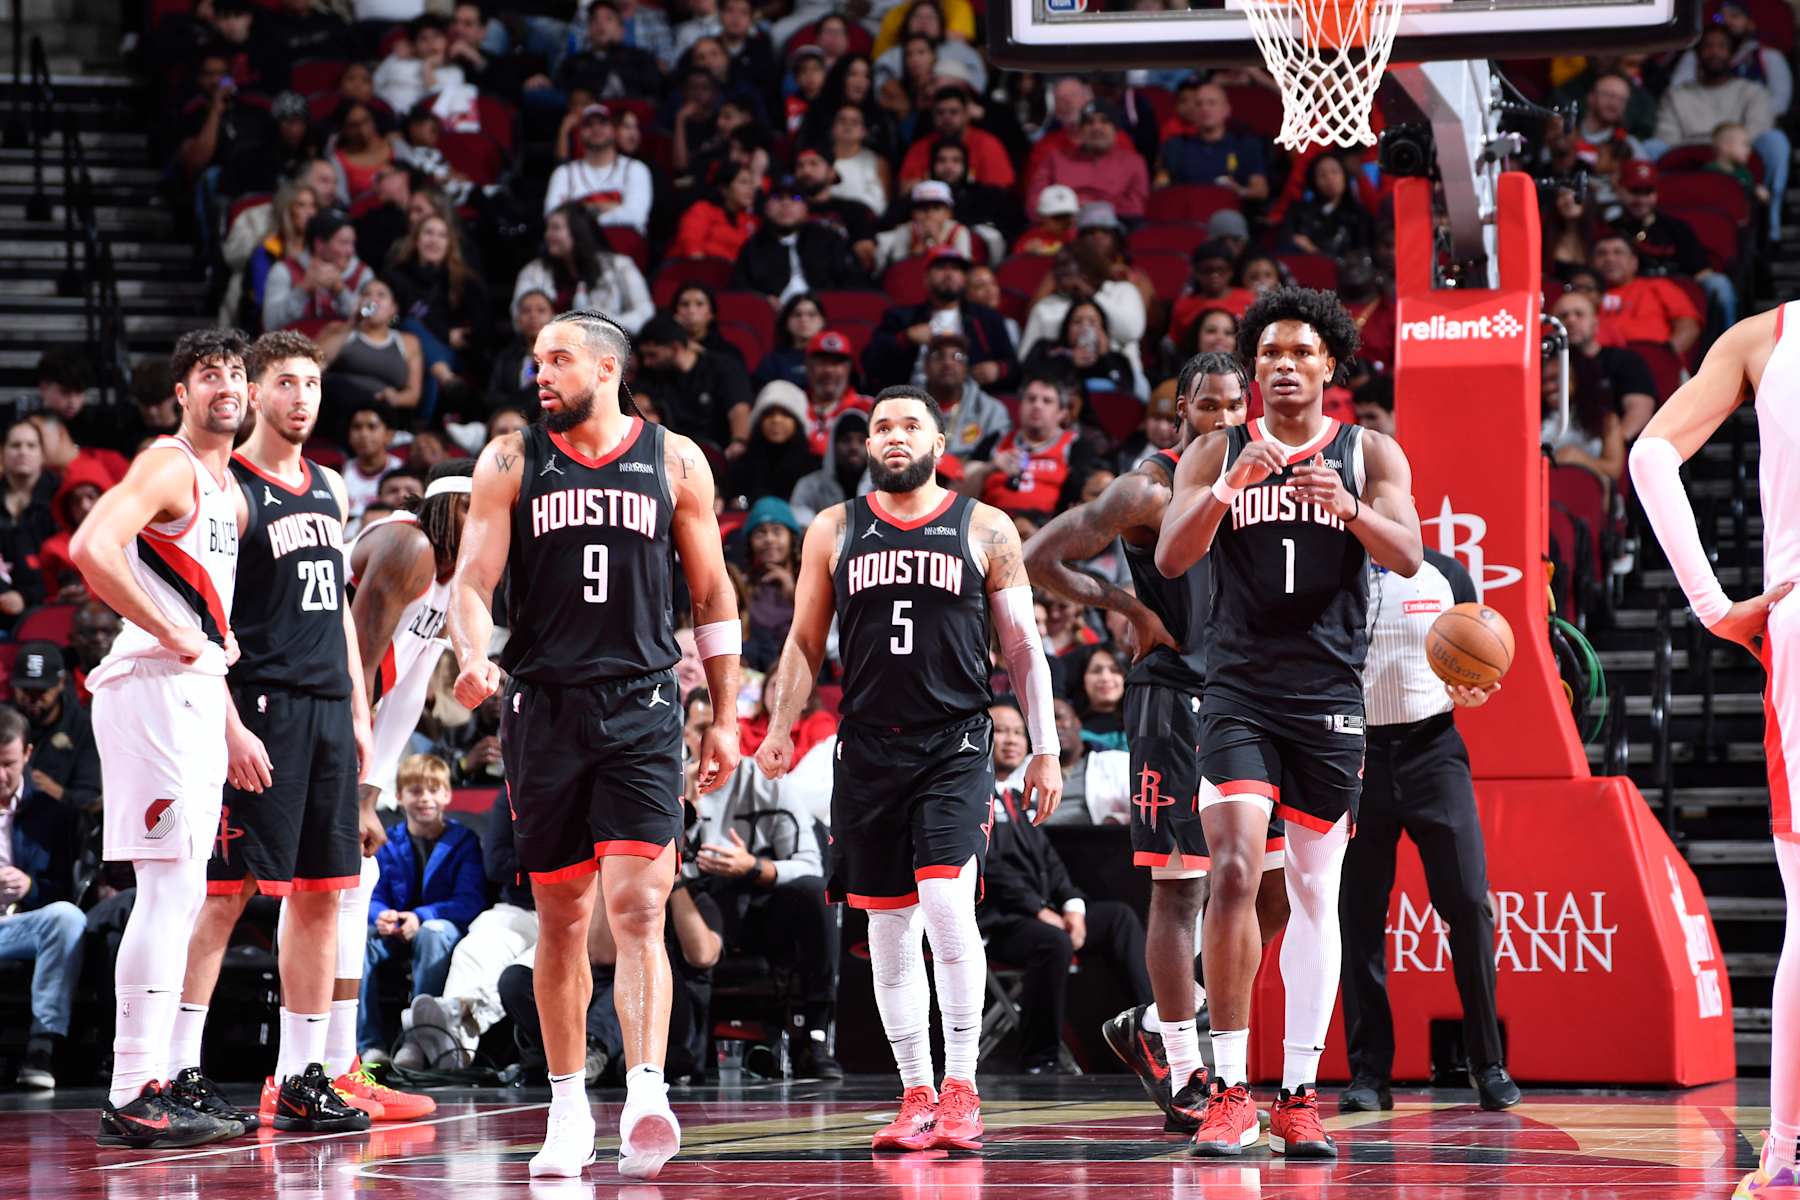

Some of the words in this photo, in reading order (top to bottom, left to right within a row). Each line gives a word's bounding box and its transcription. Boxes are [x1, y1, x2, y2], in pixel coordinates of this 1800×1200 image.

[1402, 315, 1492, 339] reliant
[267, 512, 344, 560] HOUSTO
[531, 488, 657, 540] HOUSTON
[297, 559, 339, 612] 28
[583, 544, 609, 604] 9
[848, 550, 963, 596] HOUSTON
[1282, 538, 1295, 594] 1
[890, 600, 914, 656] 5
[1384, 891, 1618, 934] MRIAL
